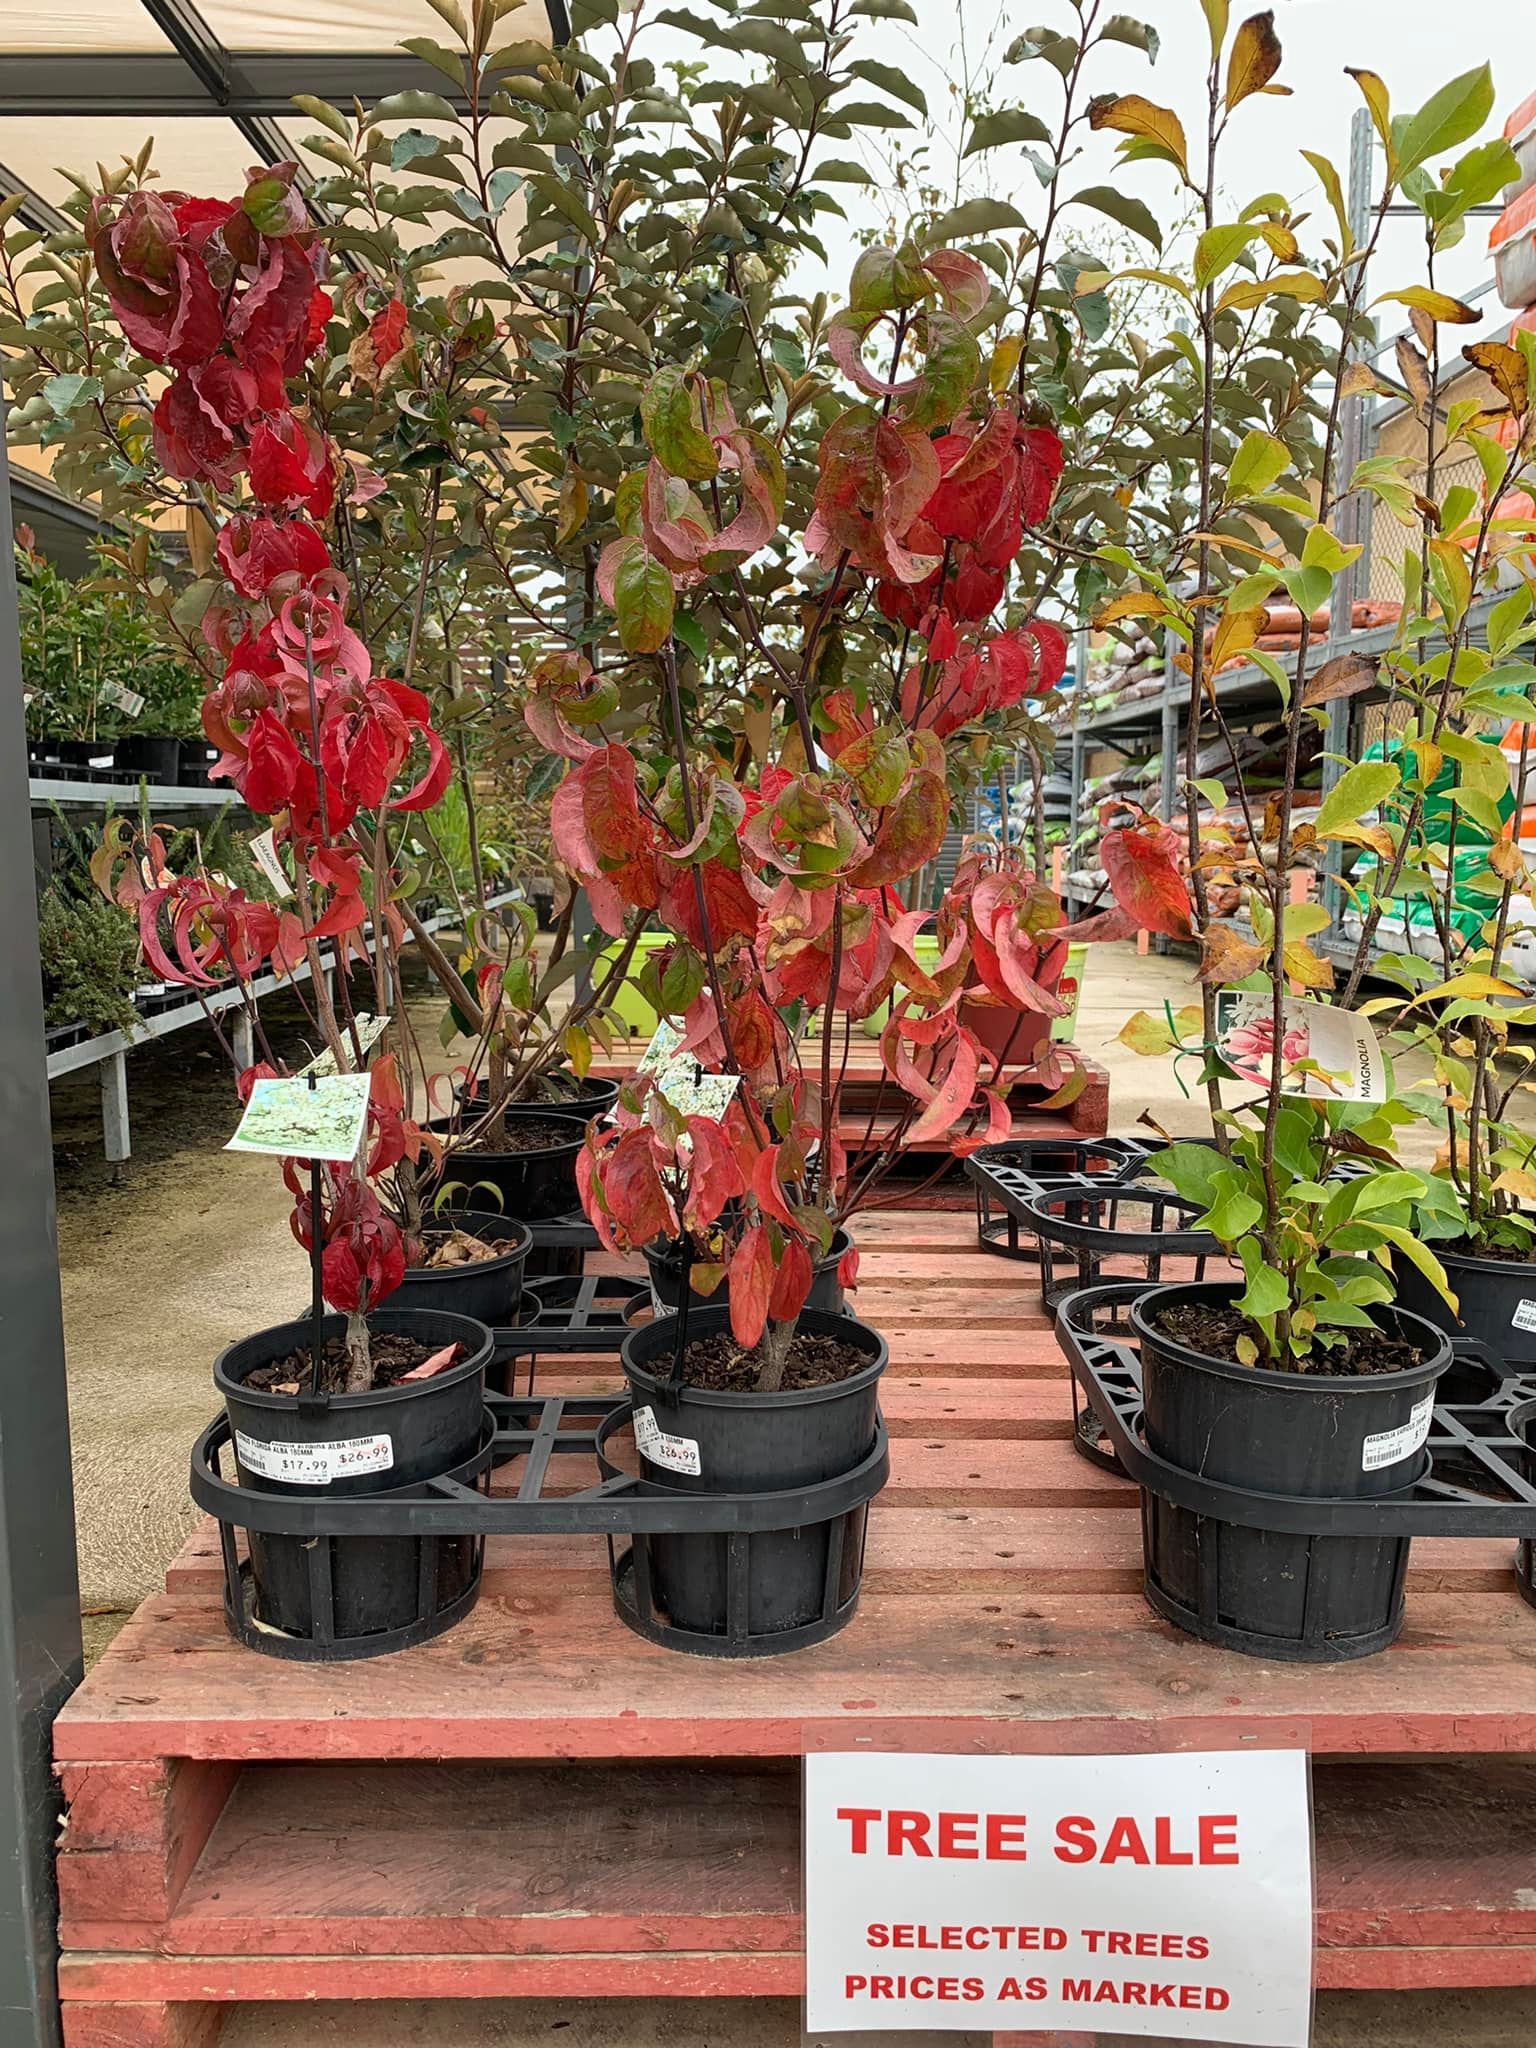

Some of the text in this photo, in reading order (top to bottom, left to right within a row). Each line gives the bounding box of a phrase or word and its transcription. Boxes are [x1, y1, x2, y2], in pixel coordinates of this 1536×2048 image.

[1356, 1039, 1371, 1098] MAGNOLIA
[327, 1441, 347, 1450] ALBA
[339, 1445, 389, 1464] $26.99
[660, 1444, 696, 1462] $26.99
[282, 1459, 328, 1470] $17.99
[836, 1807, 1240, 1866] TREE SALE
[866, 1923, 1209, 1961] SELECTED TREES
[844, 1974, 1230, 2012] PRICES AS MARKED
